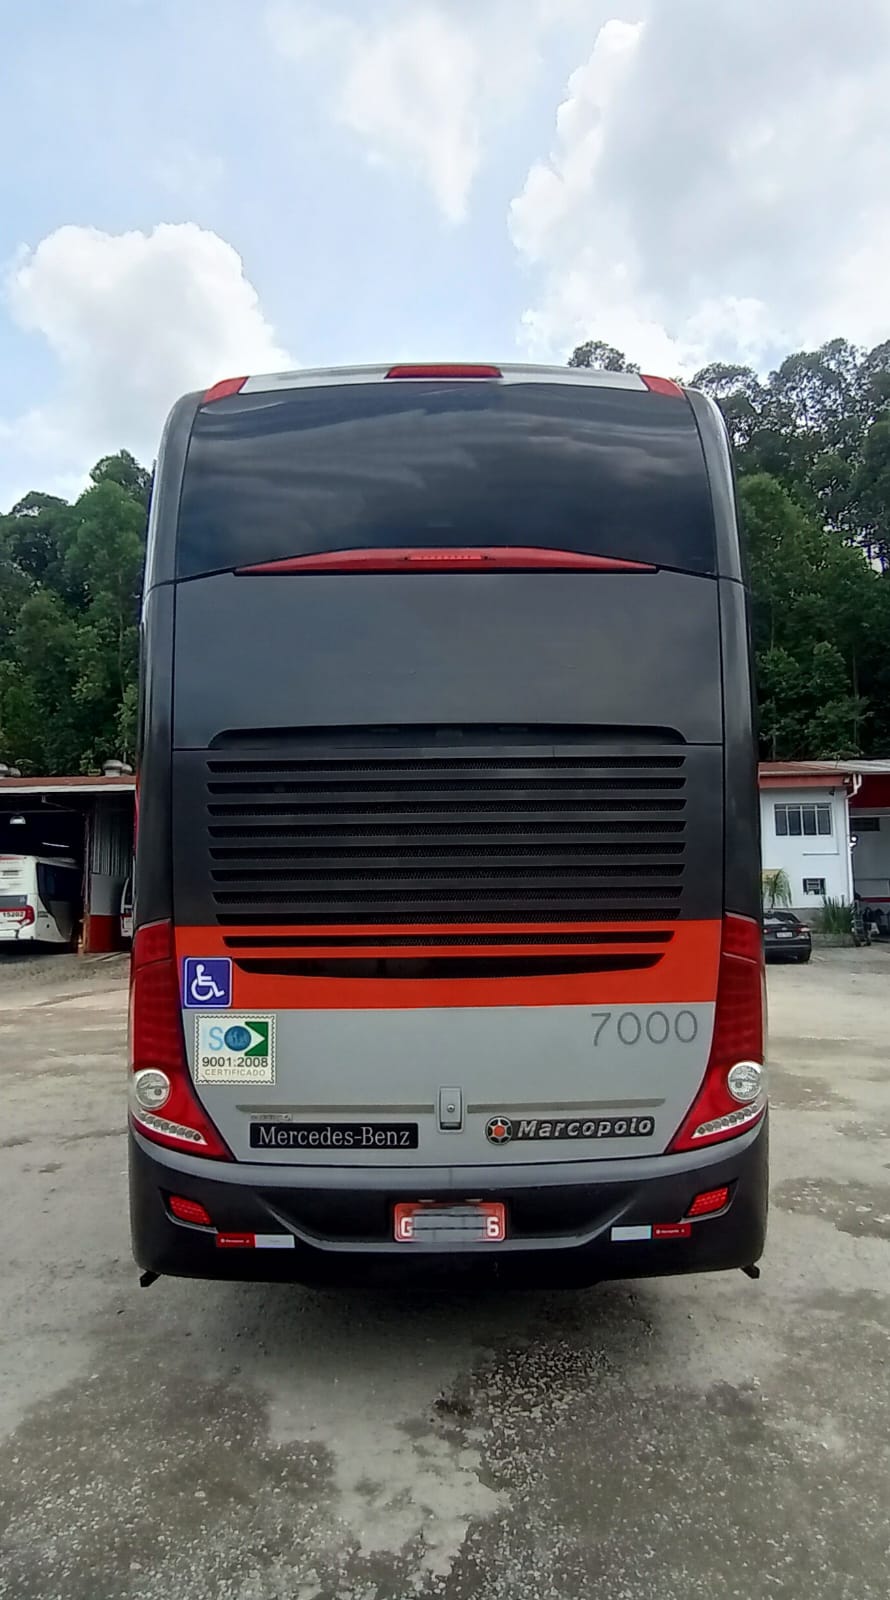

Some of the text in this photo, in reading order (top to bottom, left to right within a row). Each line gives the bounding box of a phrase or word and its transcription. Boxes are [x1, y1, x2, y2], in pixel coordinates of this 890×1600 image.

[591, 1010, 698, 1047] 7000
[202, 1056, 269, 1068] 9001:2008
[204, 1068, 266, 1077] CERTIFICADO
[258, 1126, 410, 1146] Mercedes-Benz
[517, 1117, 652, 1138] Marcopolo
